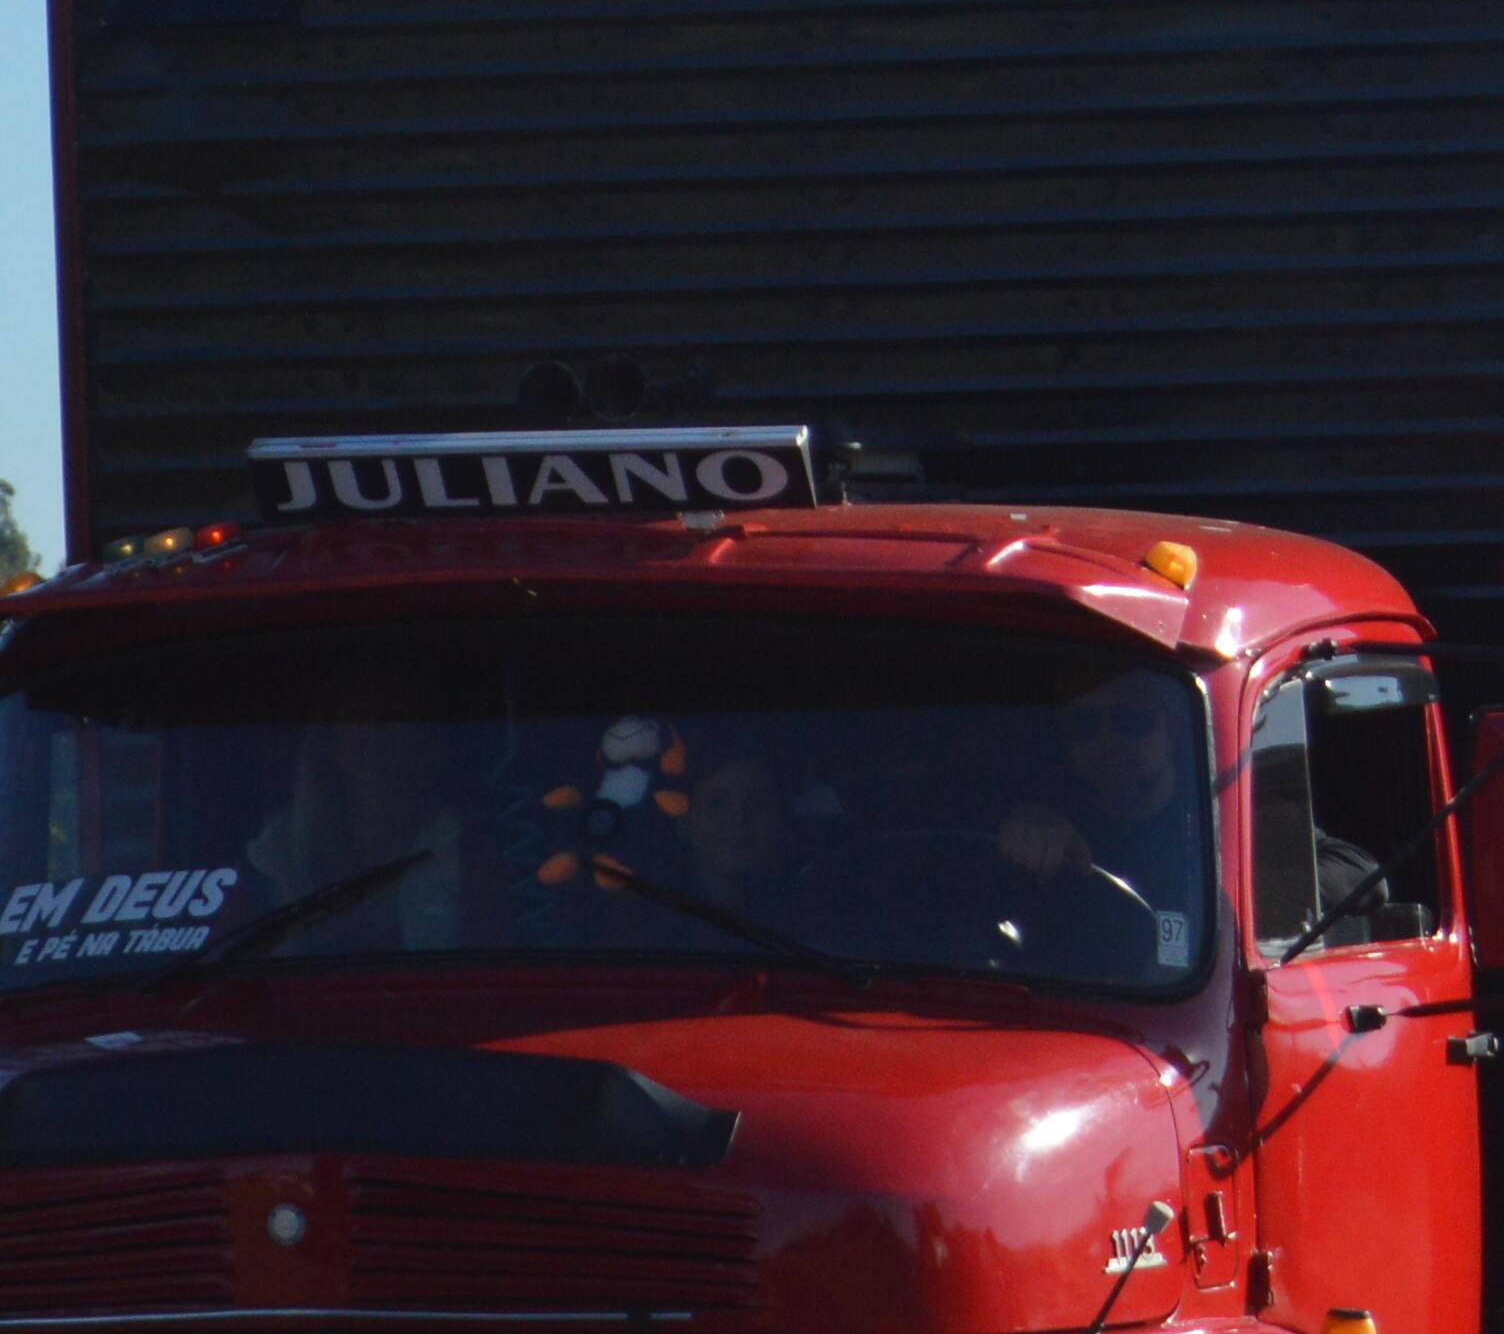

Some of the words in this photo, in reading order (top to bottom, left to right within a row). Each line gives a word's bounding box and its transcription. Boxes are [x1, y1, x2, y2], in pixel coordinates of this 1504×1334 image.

[278, 450, 788, 512] JULIANO
[0, 877, 86, 935] EM
[80, 867, 238, 925] DEUS
[13, 938, 39, 965] E
[36, 928, 79, 962] PÉ
[76, 930, 120, 958] NA
[123, 922, 210, 954] TÁBUA
[1162, 919, 1183, 942] 97
